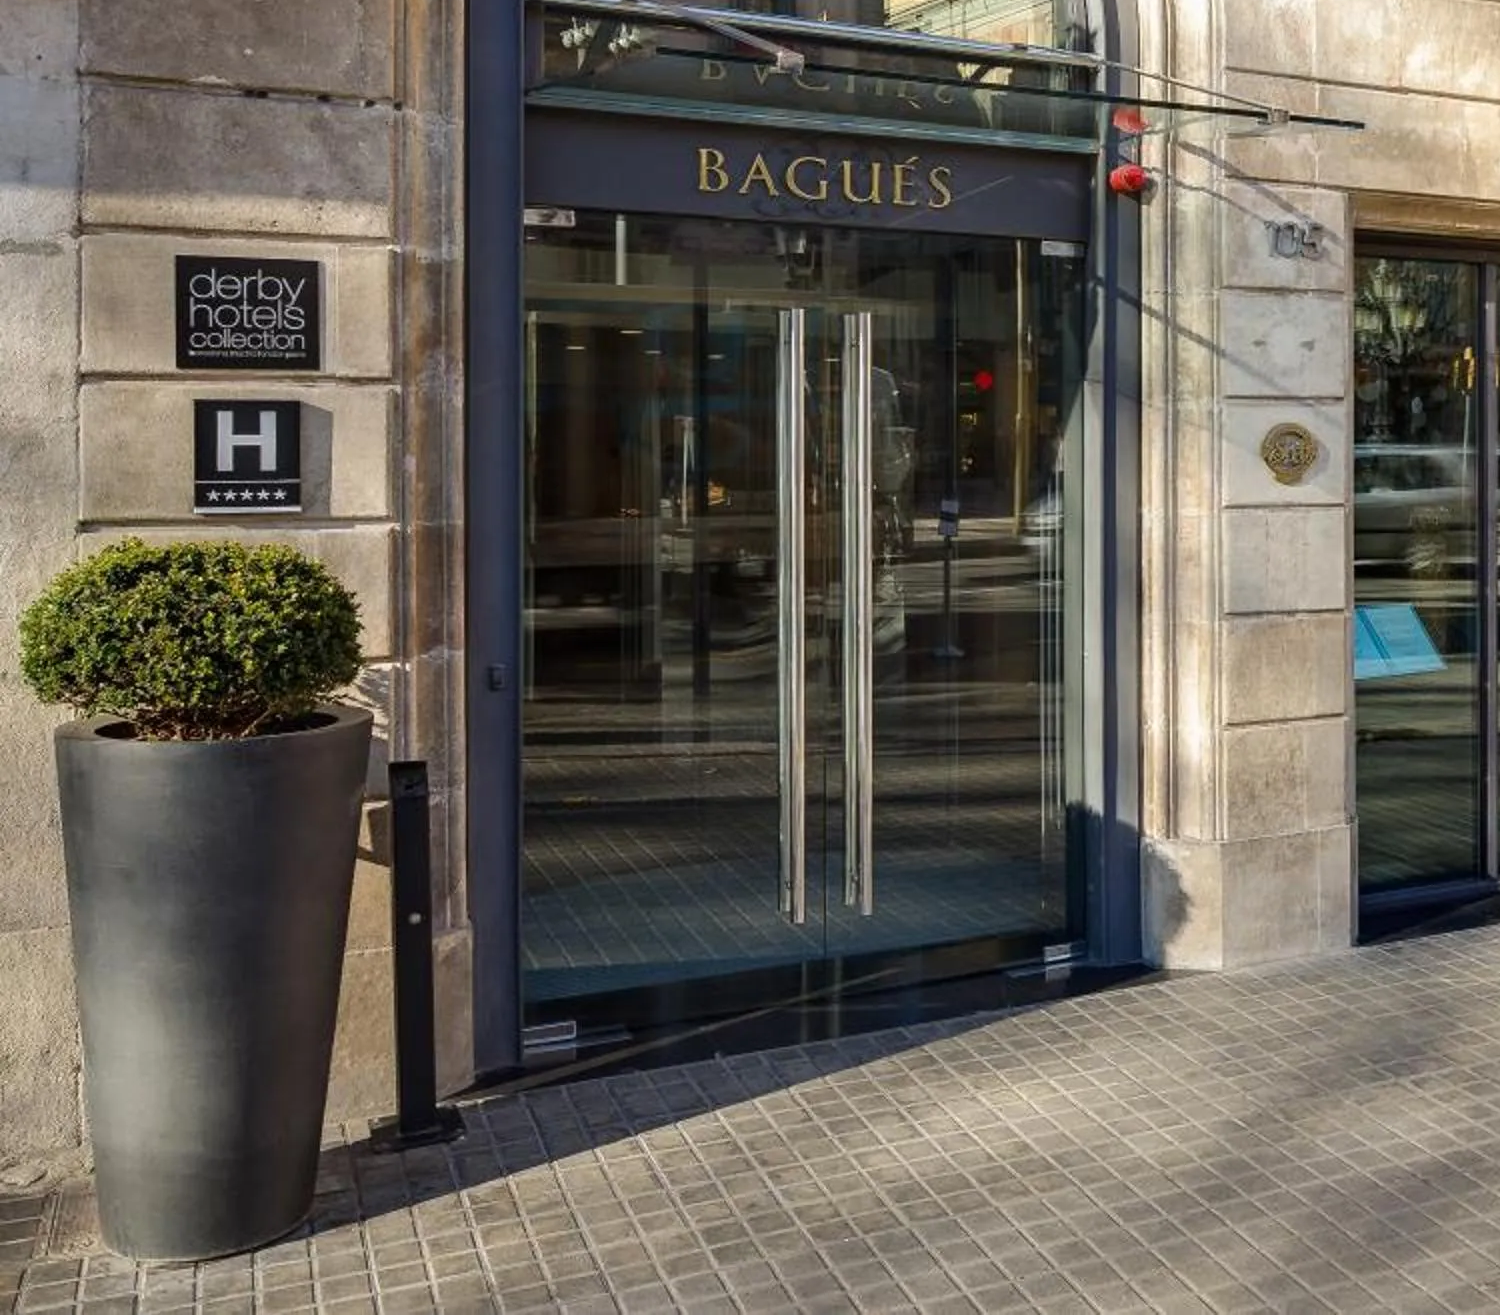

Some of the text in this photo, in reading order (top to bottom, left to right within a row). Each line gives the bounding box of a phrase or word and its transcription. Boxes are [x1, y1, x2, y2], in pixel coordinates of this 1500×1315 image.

[697, 148, 952, 209] BAGUÉS
[189, 268, 306, 307] derby
[189, 296, 306, 330] hotels
[189, 328, 306, 350] collection
[217, 410, 277, 472] H
